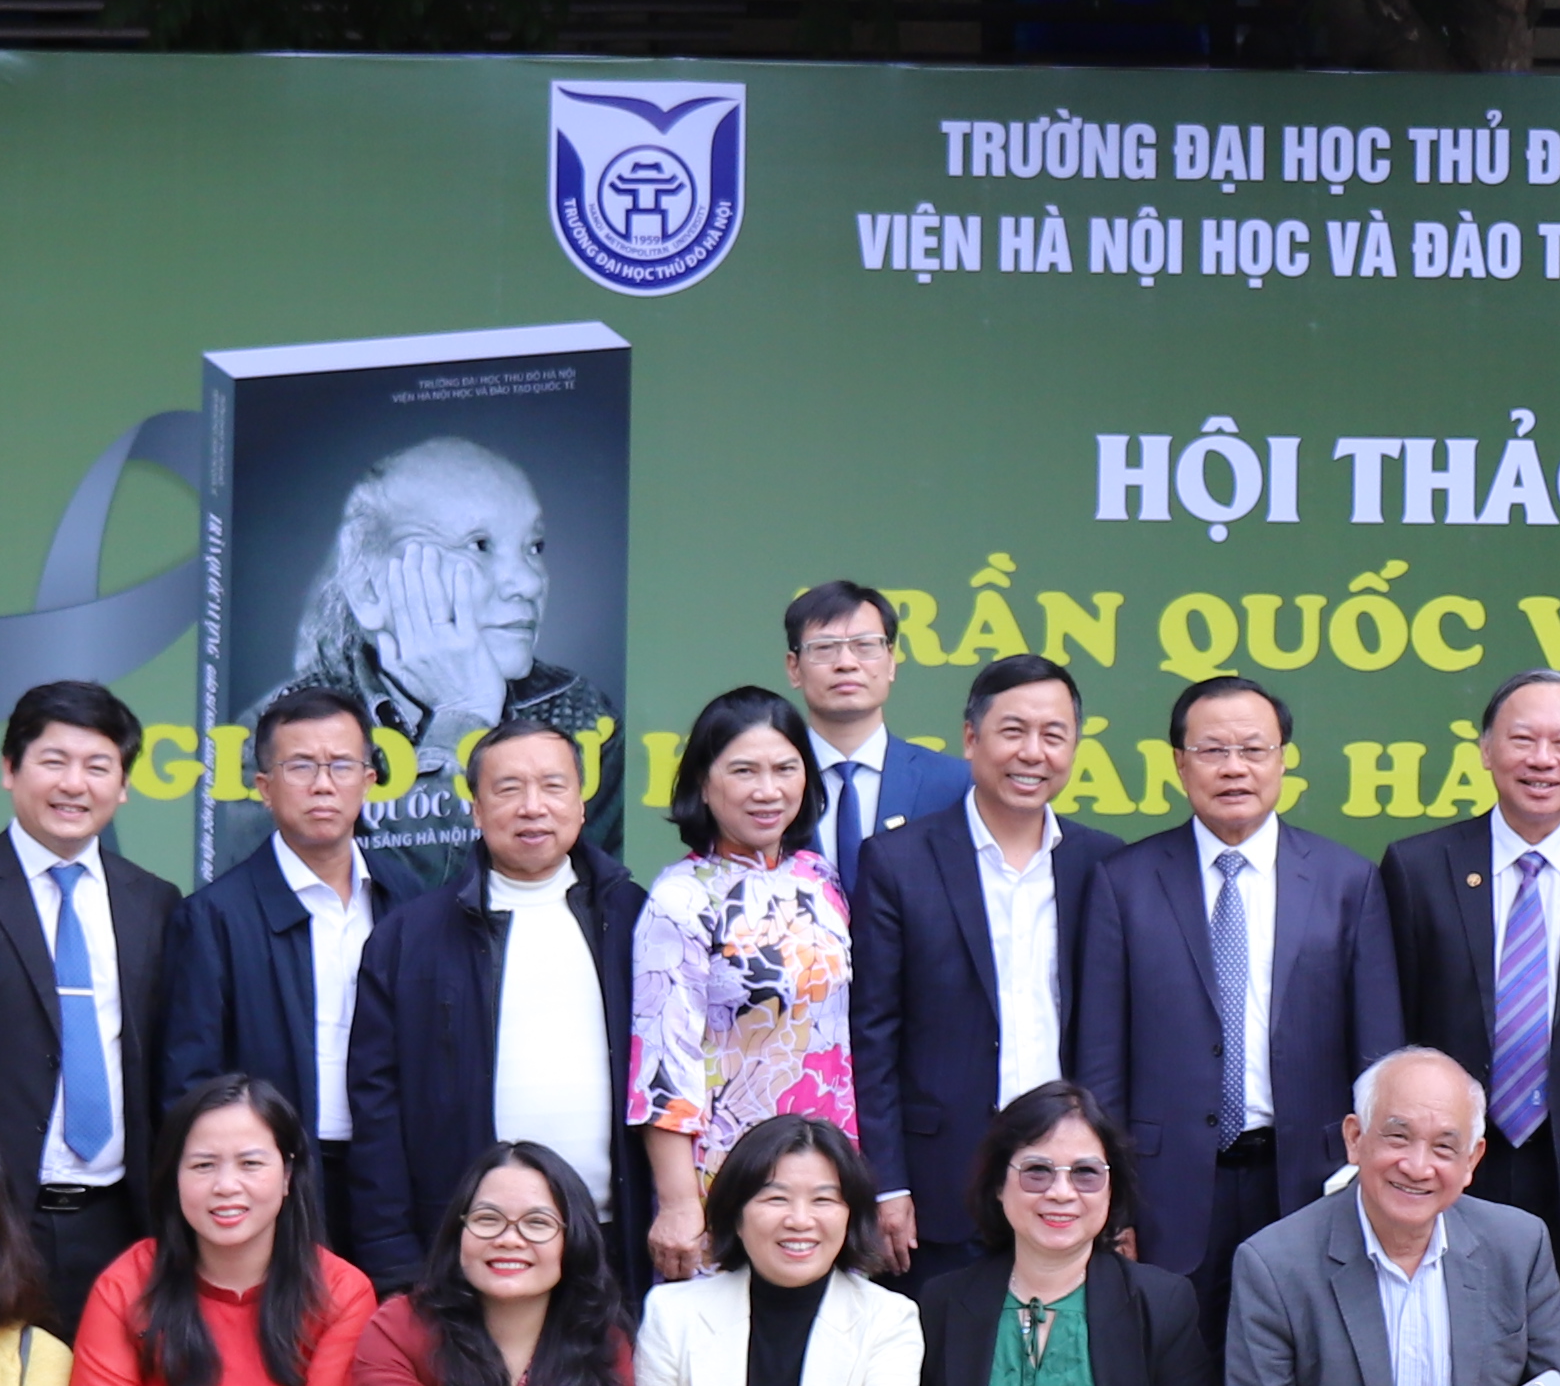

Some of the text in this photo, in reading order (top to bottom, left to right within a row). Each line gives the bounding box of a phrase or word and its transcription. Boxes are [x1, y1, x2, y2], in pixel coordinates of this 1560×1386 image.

[941, 108, 1157, 181] TRƯỜNG
[1173, 124, 1265, 194] ĐẠI
[1282, 125, 1391, 196] HỌC
[1408, 109, 1510, 185] THỦ
[563, 197, 734, 284] TRƯỜNG ĐẠI HỌC THỦ ĐÔ HÀ NỘI
[589, 202, 707, 257] HANOI METROPOLITAN UNIVERSITY
[632, 234, 661, 246] 1959
[856, 201, 982, 284] VIỆN
[999, 204, 1073, 273] HÀ
[1089, 205, 1183, 287] NỘI
[1200, 217, 1310, 289] HỌC
[1326, 210, 1397, 278] VÀ
[1412, 210, 1521, 280] ĐÀO
[1094, 416, 1302, 543] HỘI
[792, 552, 1124, 668] RẦN
[1158, 559, 1487, 682] QUỐC
[127, 723, 417, 802] GIO
[1341, 720, 1500, 818] HÀ
[373, 830, 412, 849] SÁNG
[416, 827, 437, 845] HÀ
[441, 825, 467, 846] NỘI
